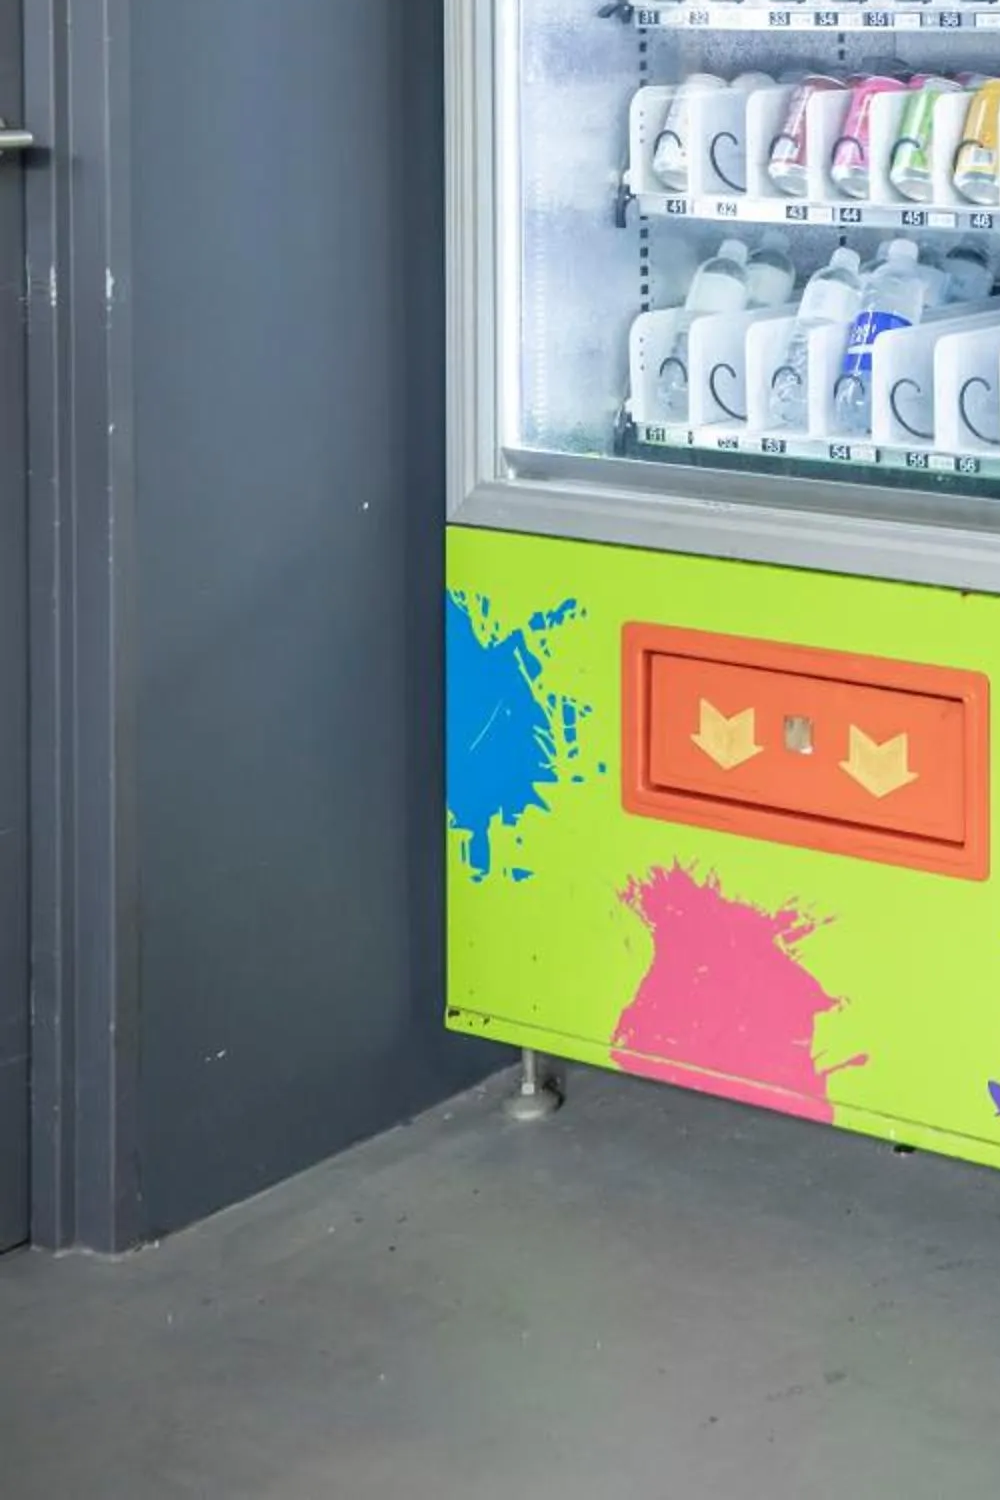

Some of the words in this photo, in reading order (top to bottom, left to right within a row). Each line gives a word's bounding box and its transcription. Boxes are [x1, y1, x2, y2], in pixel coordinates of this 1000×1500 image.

[943, 13, 958, 26] 36
[905, 213, 921, 225] 45
[974, 215, 990, 227] 46
[909, 454, 925, 466] 55
[959, 459, 975, 471] 56
